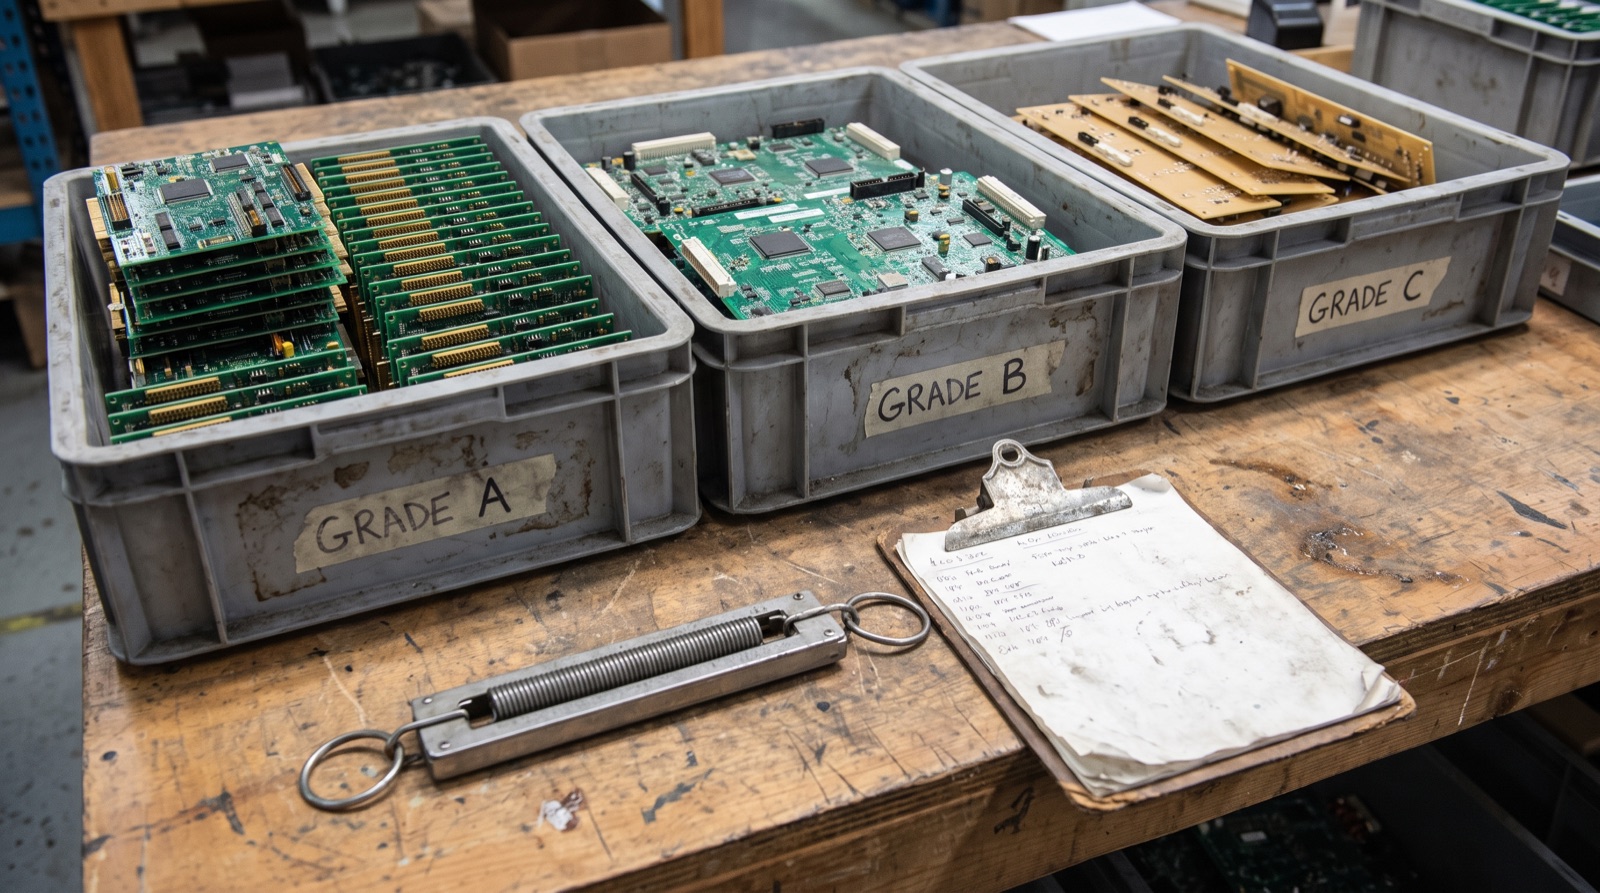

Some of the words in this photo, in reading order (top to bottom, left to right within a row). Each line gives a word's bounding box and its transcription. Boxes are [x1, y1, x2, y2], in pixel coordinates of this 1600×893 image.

[1308, 278, 1392, 325] GRADE
[1403, 270, 1425, 302] C
[877, 370, 983, 422] GRADE
[1003, 358, 1027, 394] B
[316, 492, 454, 554] GRADE
[478, 477, 512, 518] A
